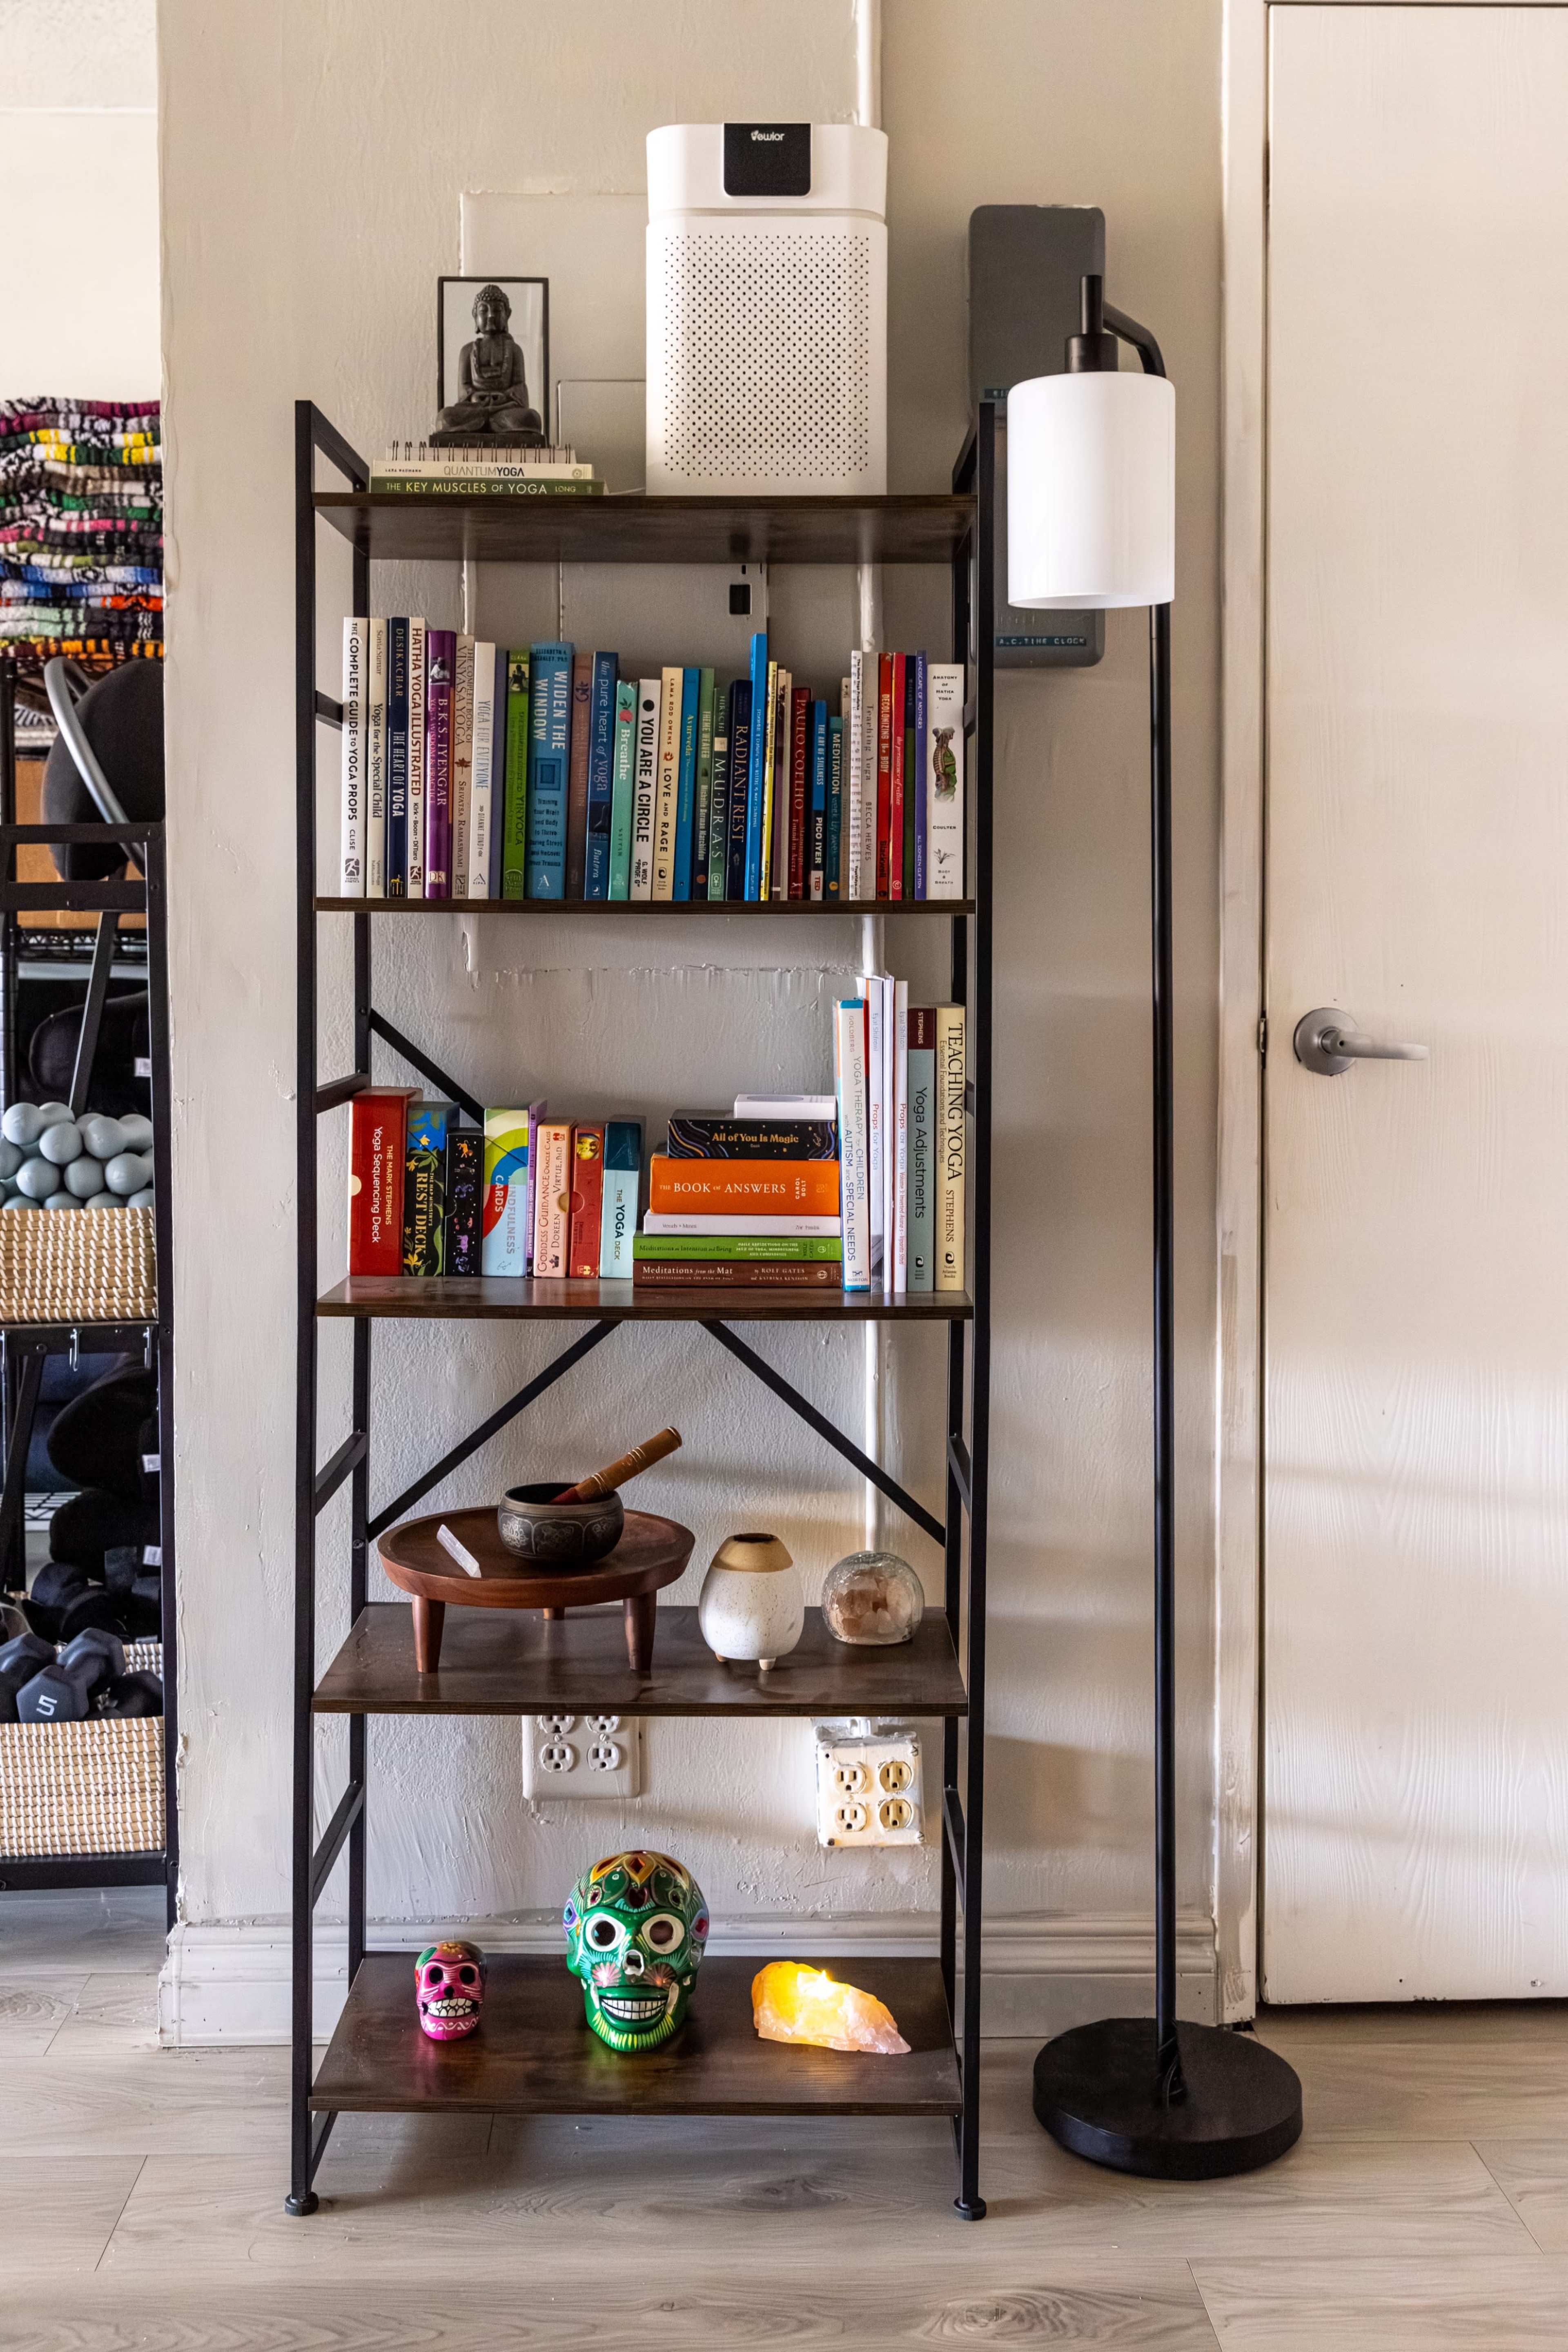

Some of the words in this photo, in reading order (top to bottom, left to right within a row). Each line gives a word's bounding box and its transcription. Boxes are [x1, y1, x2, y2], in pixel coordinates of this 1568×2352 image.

[406, 482, 428, 492] KEY
[432, 484, 486, 493] MUSCLES
[508, 484, 547, 494] YOGA
[396, 629, 404, 696] DESIKACHAR
[412, 628, 422, 671] HATHA
[350, 638, 359, 697] COMPLETE
[456, 645, 466, 702] VINYASA
[412, 676, 421, 709] YOGA
[534, 679, 548, 740] WINDOW
[553, 671, 568, 718] WIDEN
[598, 680, 608, 706] pure
[349, 700, 358, 735] GUIDE
[372, 703, 383, 727] Yoga
[438, 699, 448, 738] B.K.S.
[455, 707, 466, 746] YOGA
[477, 701, 490, 723] YOGA
[598, 712, 610, 742] heart
[796, 699, 806, 745] PAULO
[864, 705, 873, 751] Teaching
[881, 694, 890, 739] DECOLONIZING
[373, 729, 382, 740] for
[373, 742, 382, 754] the
[393, 732, 405, 745] THE
[477, 728, 490, 742] FOR
[552, 724, 566, 750] THE
[641, 719, 654, 745] YOU
[349, 749, 358, 780] YOGA
[393, 749, 405, 772] HEART
[411, 713, 421, 796] ILLUSTRATED
[476, 747, 490, 789] EVERYONE
[596, 746, 606, 757] of
[619, 729, 630, 780] Breathe
[639, 749, 653, 777] ARE
[734, 726, 748, 800] RADIANT
[832, 734, 841, 794] MEDITATION
[864, 756, 873, 780] Yoga
[880, 756, 889, 773] BODY
[371, 757, 382, 791] Special
[393, 776, 404, 785] OF
[437, 745, 448, 805] IYENGAR
[594, 759, 608, 791] yoga
[639, 781, 651, 789] A
[663, 768, 672, 797] LOVE
[795, 750, 805, 809] COELHO
[348, 785, 357, 820] PROPS
[372, 793, 382, 818] Child
[392, 789, 404, 816] YOGA
[636, 794, 651, 842] CIRCLE
[660, 822, 669, 852] RAGE
[732, 805, 745, 843] REST
[430, 872, 444, 881] DK
[948, 1023, 963, 1119] TEACHING
[855, 1089, 863, 1136] THERAPY
[913, 1087, 927, 1123] Yoga
[372, 1126, 383, 1150] Yoga
[712, 1133, 726, 1142] All
[728, 1133, 738, 1142] of
[739, 1133, 757, 1142] You
[760, 1133, 767, 1142] Is
[770, 1134, 799, 1144] Magic
[938, 1127, 947, 1164] Techniques
[948, 1124, 963, 1181] YOGA
[371, 1154, 382, 1213] Sequencing
[673, 1183, 710, 1193] BOOK
[724, 1183, 786, 1193] ANSWERS
[856, 1149, 864, 1199] CHILDREN
[913, 1127, 927, 1218] Adjustments
[416, 1173, 428, 1211] REST
[495, 1175, 504, 1212] CARDS
[539, 1175, 550, 1227] GUIDANCE
[846, 1182, 855, 1224] SPECIAL
[372, 1217, 381, 1243] Deck
[551, 1214, 560, 1248] DOREEN
[615, 1204, 625, 1239] YOGA
[946, 1190, 954, 1242] STEPHENS
[414, 1215, 427, 1255] DECK
[537, 1231, 548, 1272] GODDESS
[847, 1228, 855, 1261] NEEDS
[36, 1695, 57, 1716] 5
